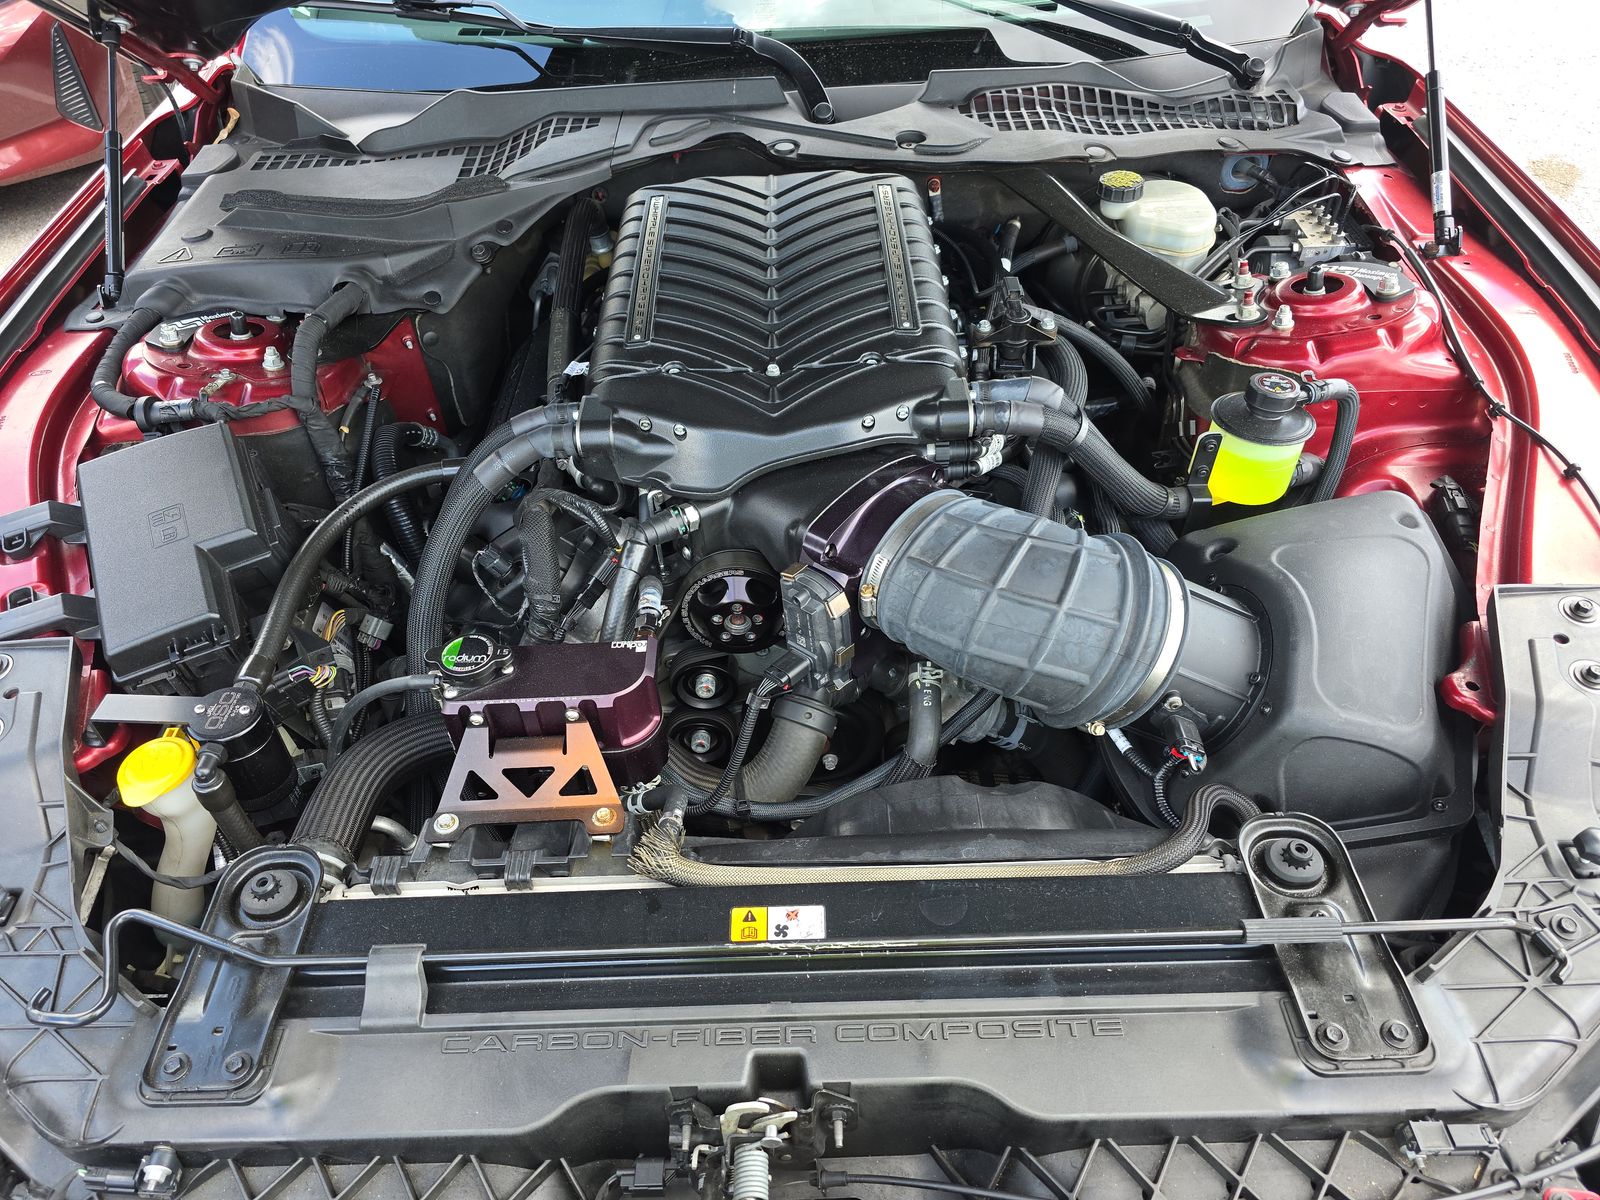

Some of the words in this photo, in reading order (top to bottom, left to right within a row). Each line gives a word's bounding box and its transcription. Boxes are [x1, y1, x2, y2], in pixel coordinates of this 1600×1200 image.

[649, 201, 661, 238] WHIPPLE
[443, 653, 487, 662] radium
[441, 1026, 816, 1055] CARBON-FIBER
[835, 1018, 1125, 1043] COMPOSITE
